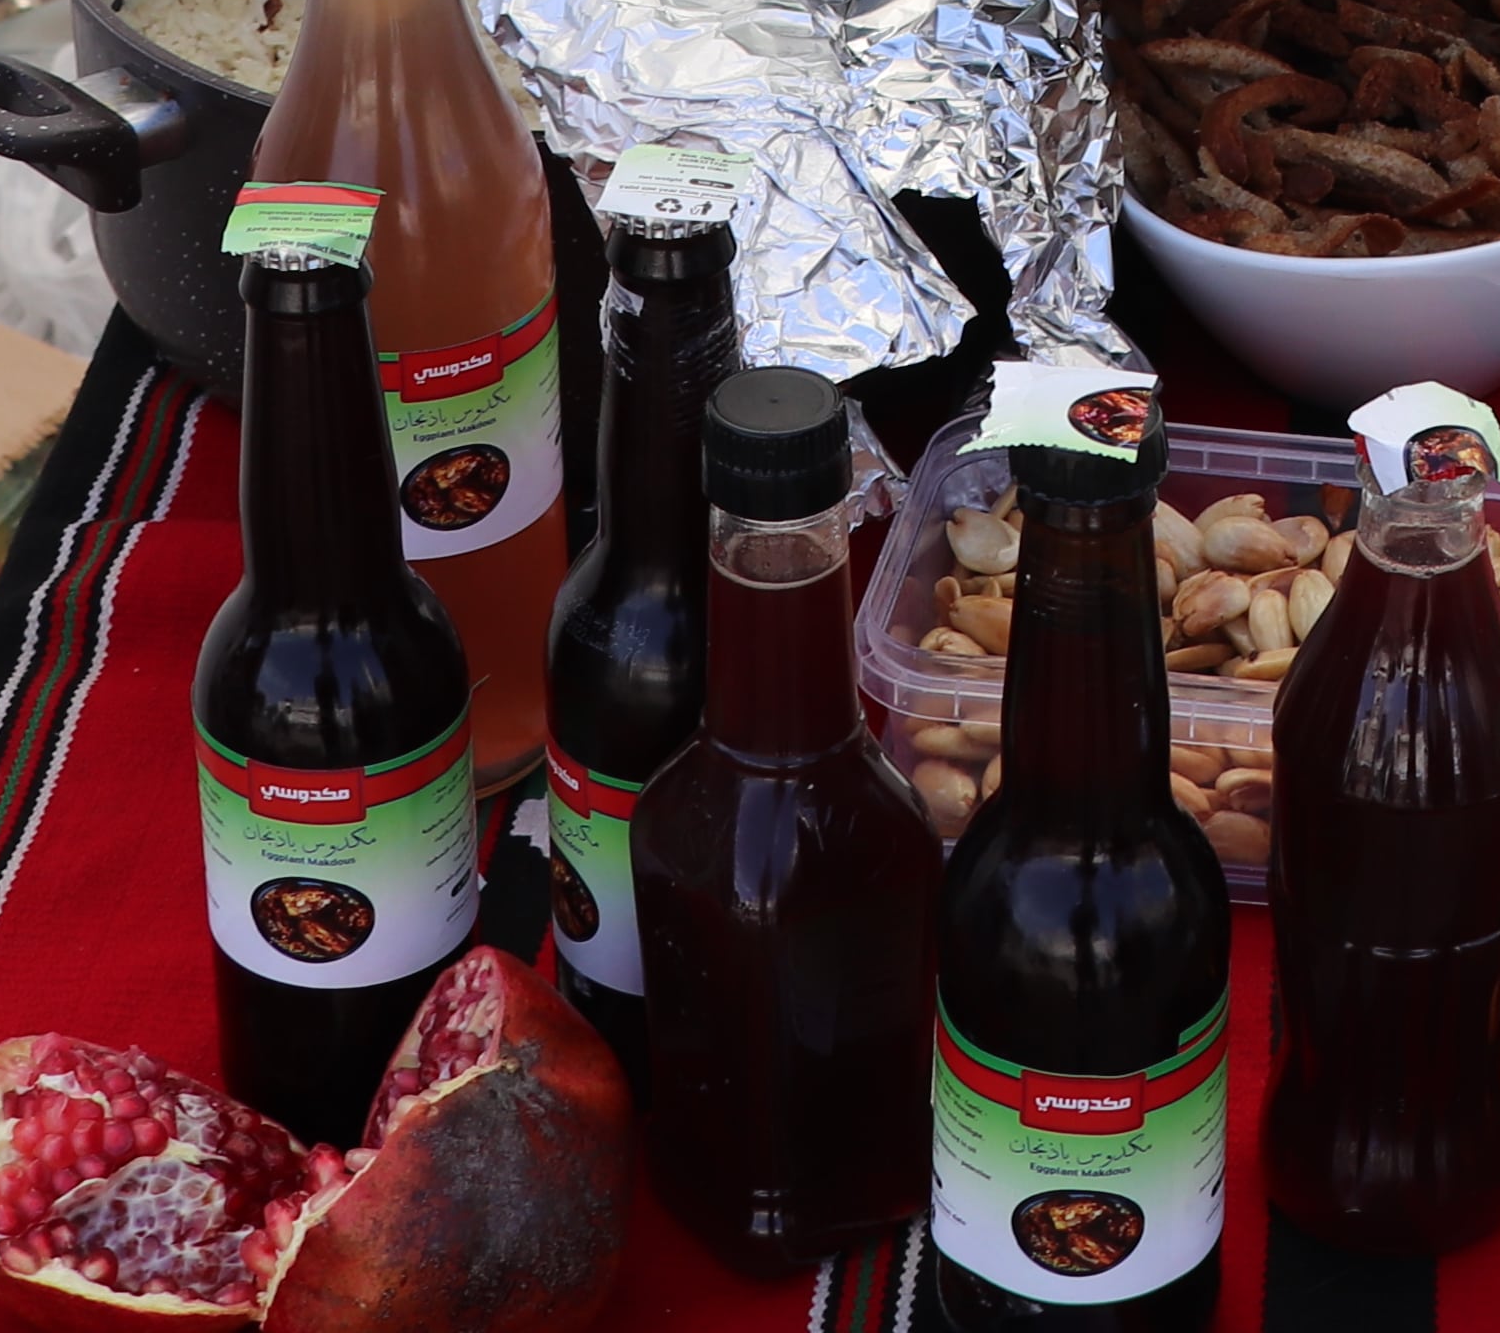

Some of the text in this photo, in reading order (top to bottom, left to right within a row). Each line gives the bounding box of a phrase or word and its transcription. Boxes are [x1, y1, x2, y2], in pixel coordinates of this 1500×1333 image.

[412, 352, 493, 385] مكدوسي
[260, 785, 350, 804] مكدوسي
[261, 848, 357, 868] Eggplant Makdous
[1035, 1094, 1132, 1114] مكدوسي
[1029, 1162, 1132, 1178] Eggplant Makdous
